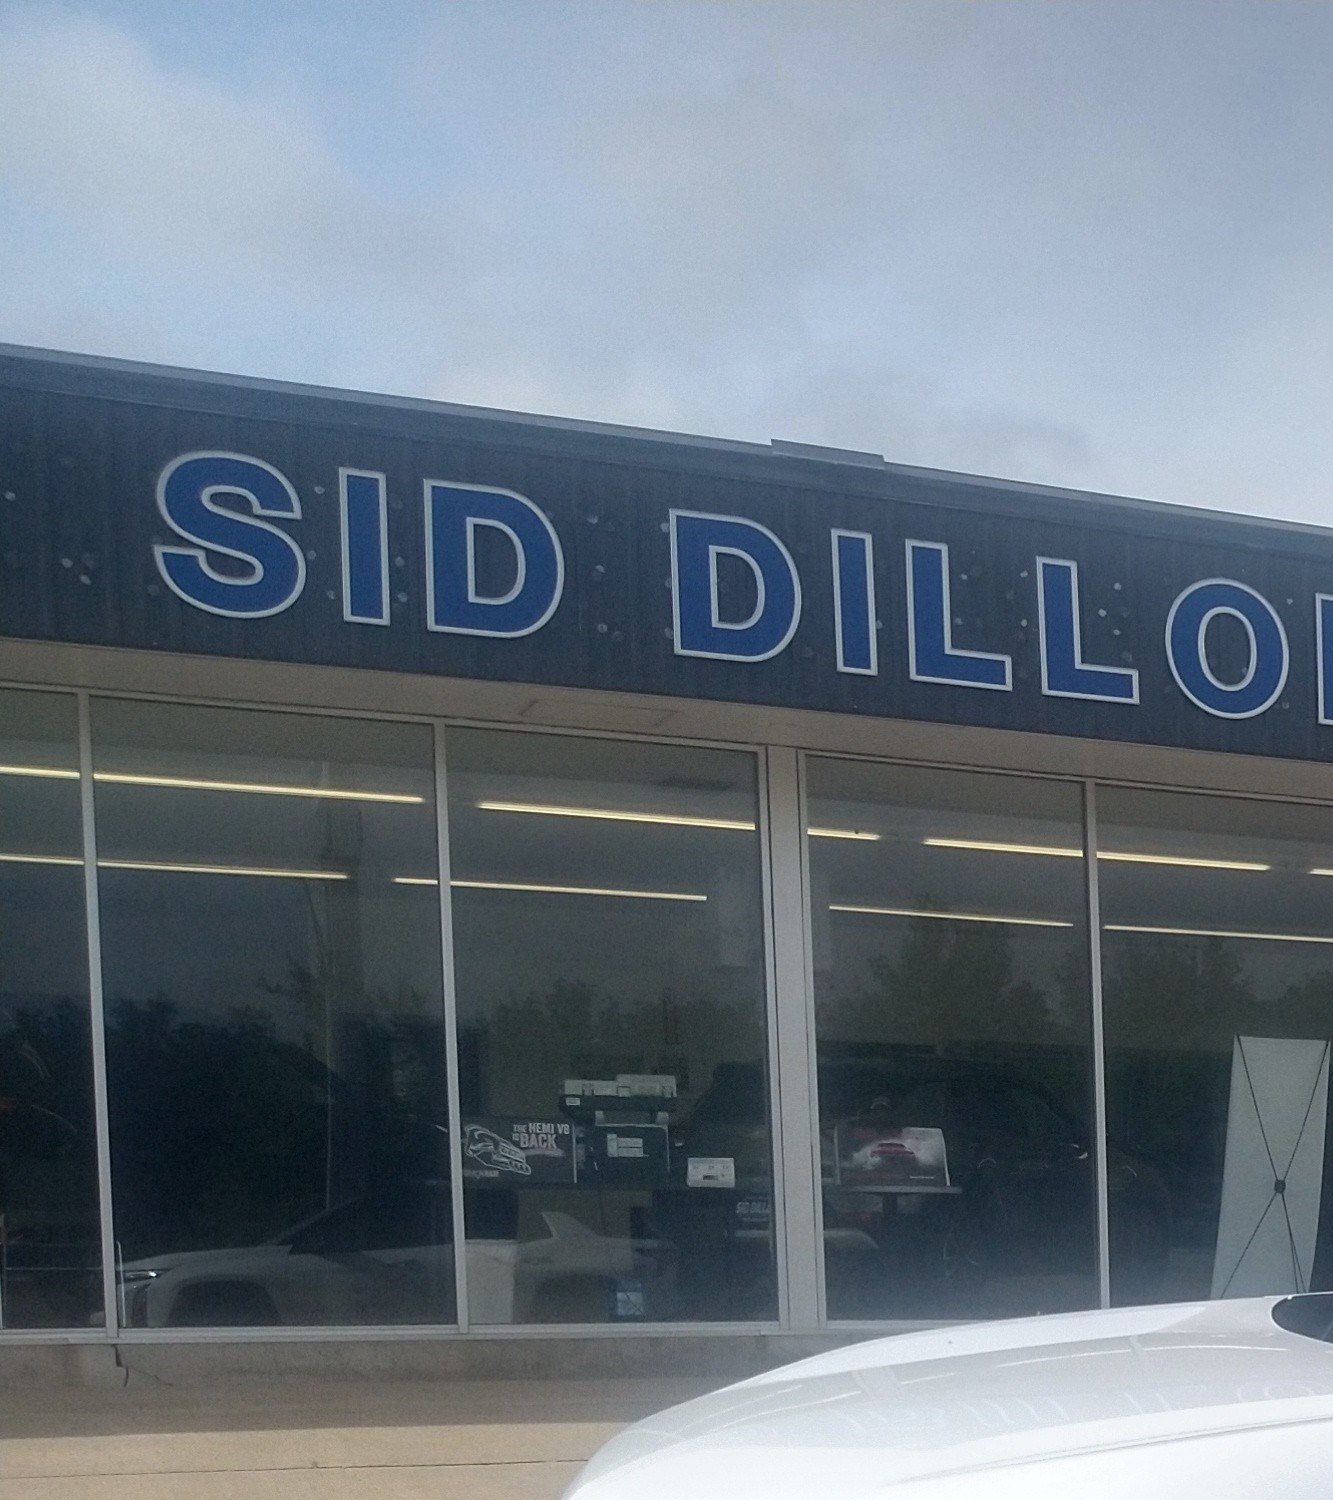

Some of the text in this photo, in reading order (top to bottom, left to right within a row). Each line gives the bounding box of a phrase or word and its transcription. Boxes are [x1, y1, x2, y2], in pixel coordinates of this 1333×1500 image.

[153, 450, 564, 639] SID
[528, 1122, 555, 1133] HEMI
[557, 1123, 570, 1135] V8
[520, 1133, 557, 1149] BACK
